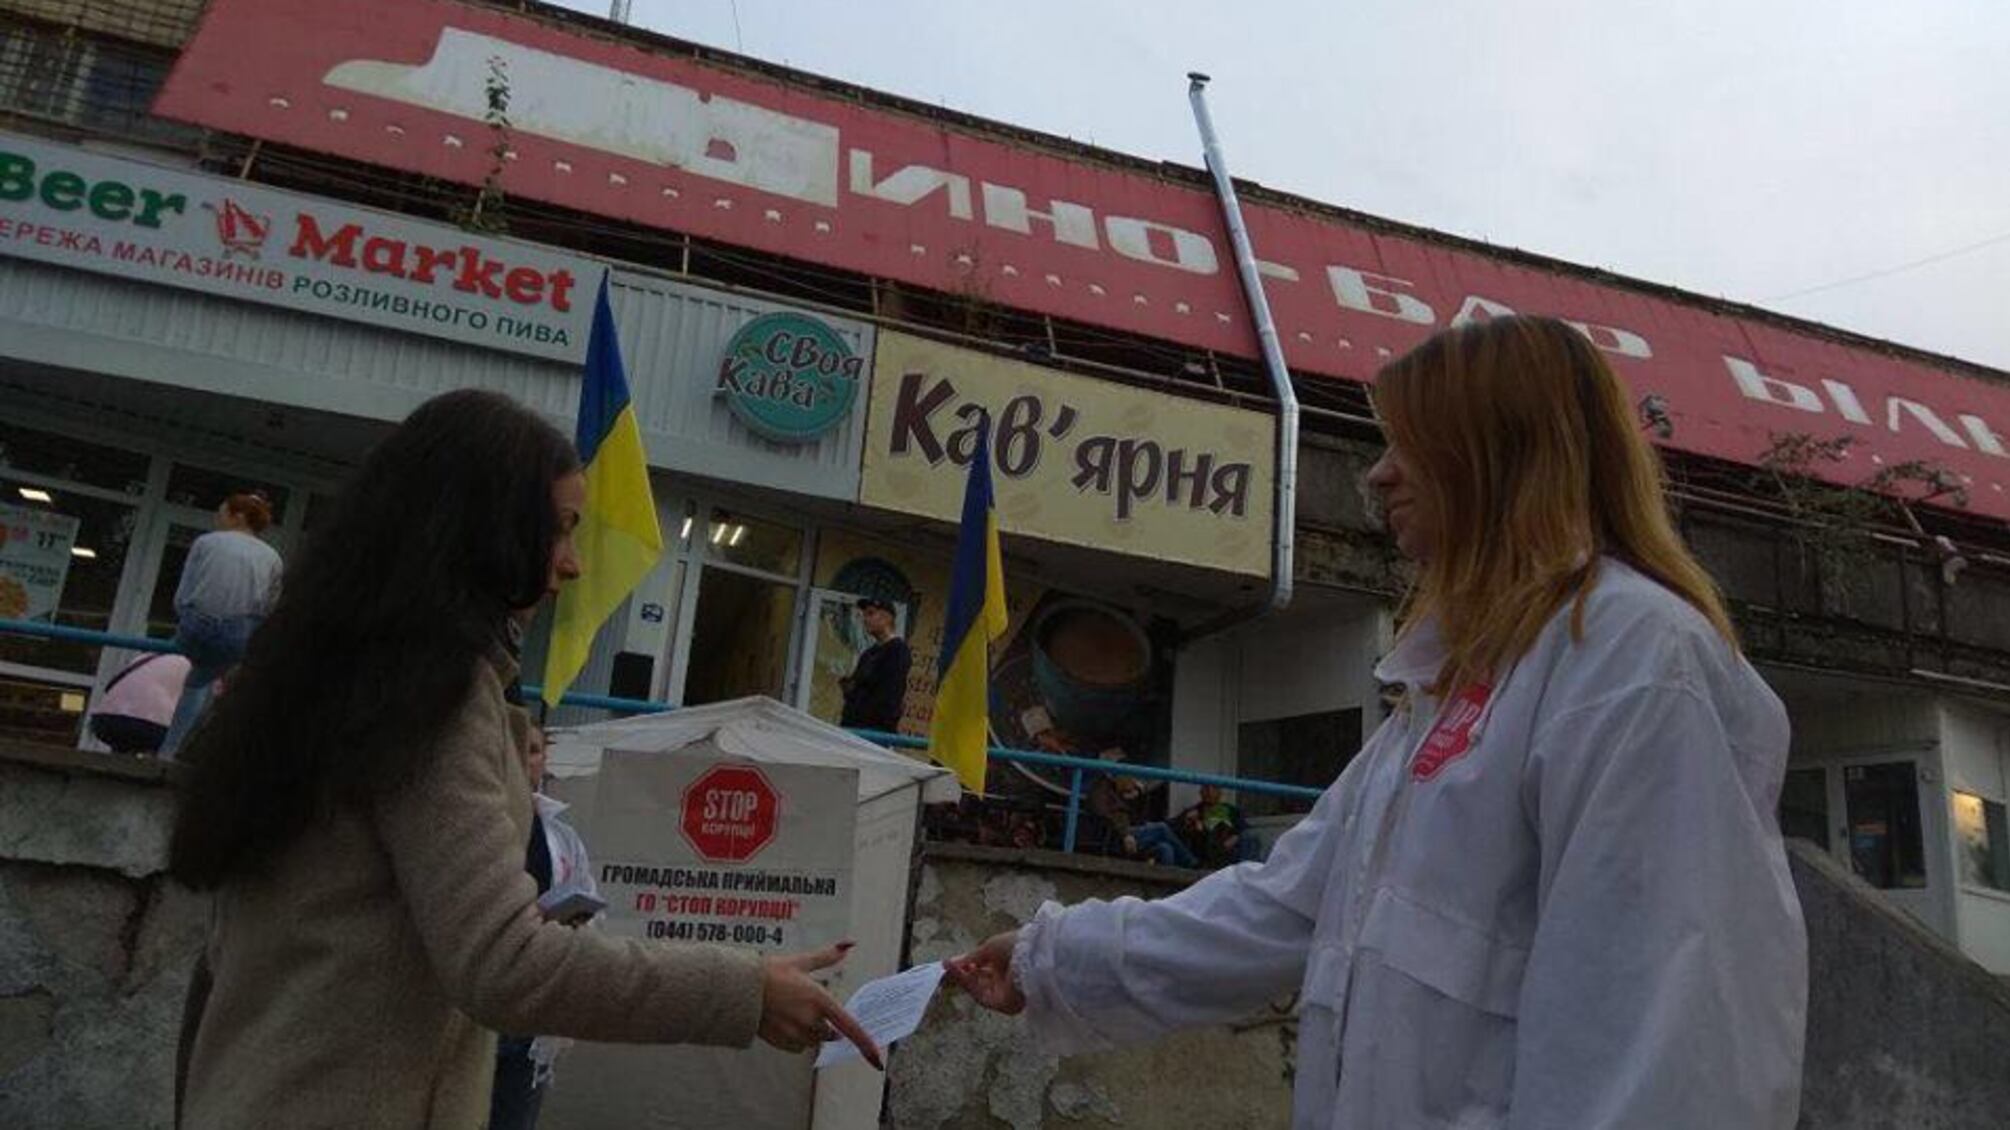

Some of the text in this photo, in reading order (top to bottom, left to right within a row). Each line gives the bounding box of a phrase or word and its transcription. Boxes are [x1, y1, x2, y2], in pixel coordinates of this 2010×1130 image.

[290, 212, 576, 313] Market
[111, 241, 284, 289] МАГАЗИНІВ
[293, 276, 488, 329] РОЗЛИВНОГО
[496, 317, 570, 347] ПИВА
[717, 356, 815, 409] Кава
[703, 789, 758, 822] STOP
[602, 865, 836, 896] ГРОМАДСЬКА ПРИЙМАЛЬНЯ
[647, 921, 783, 945] (044) 578-000-4
